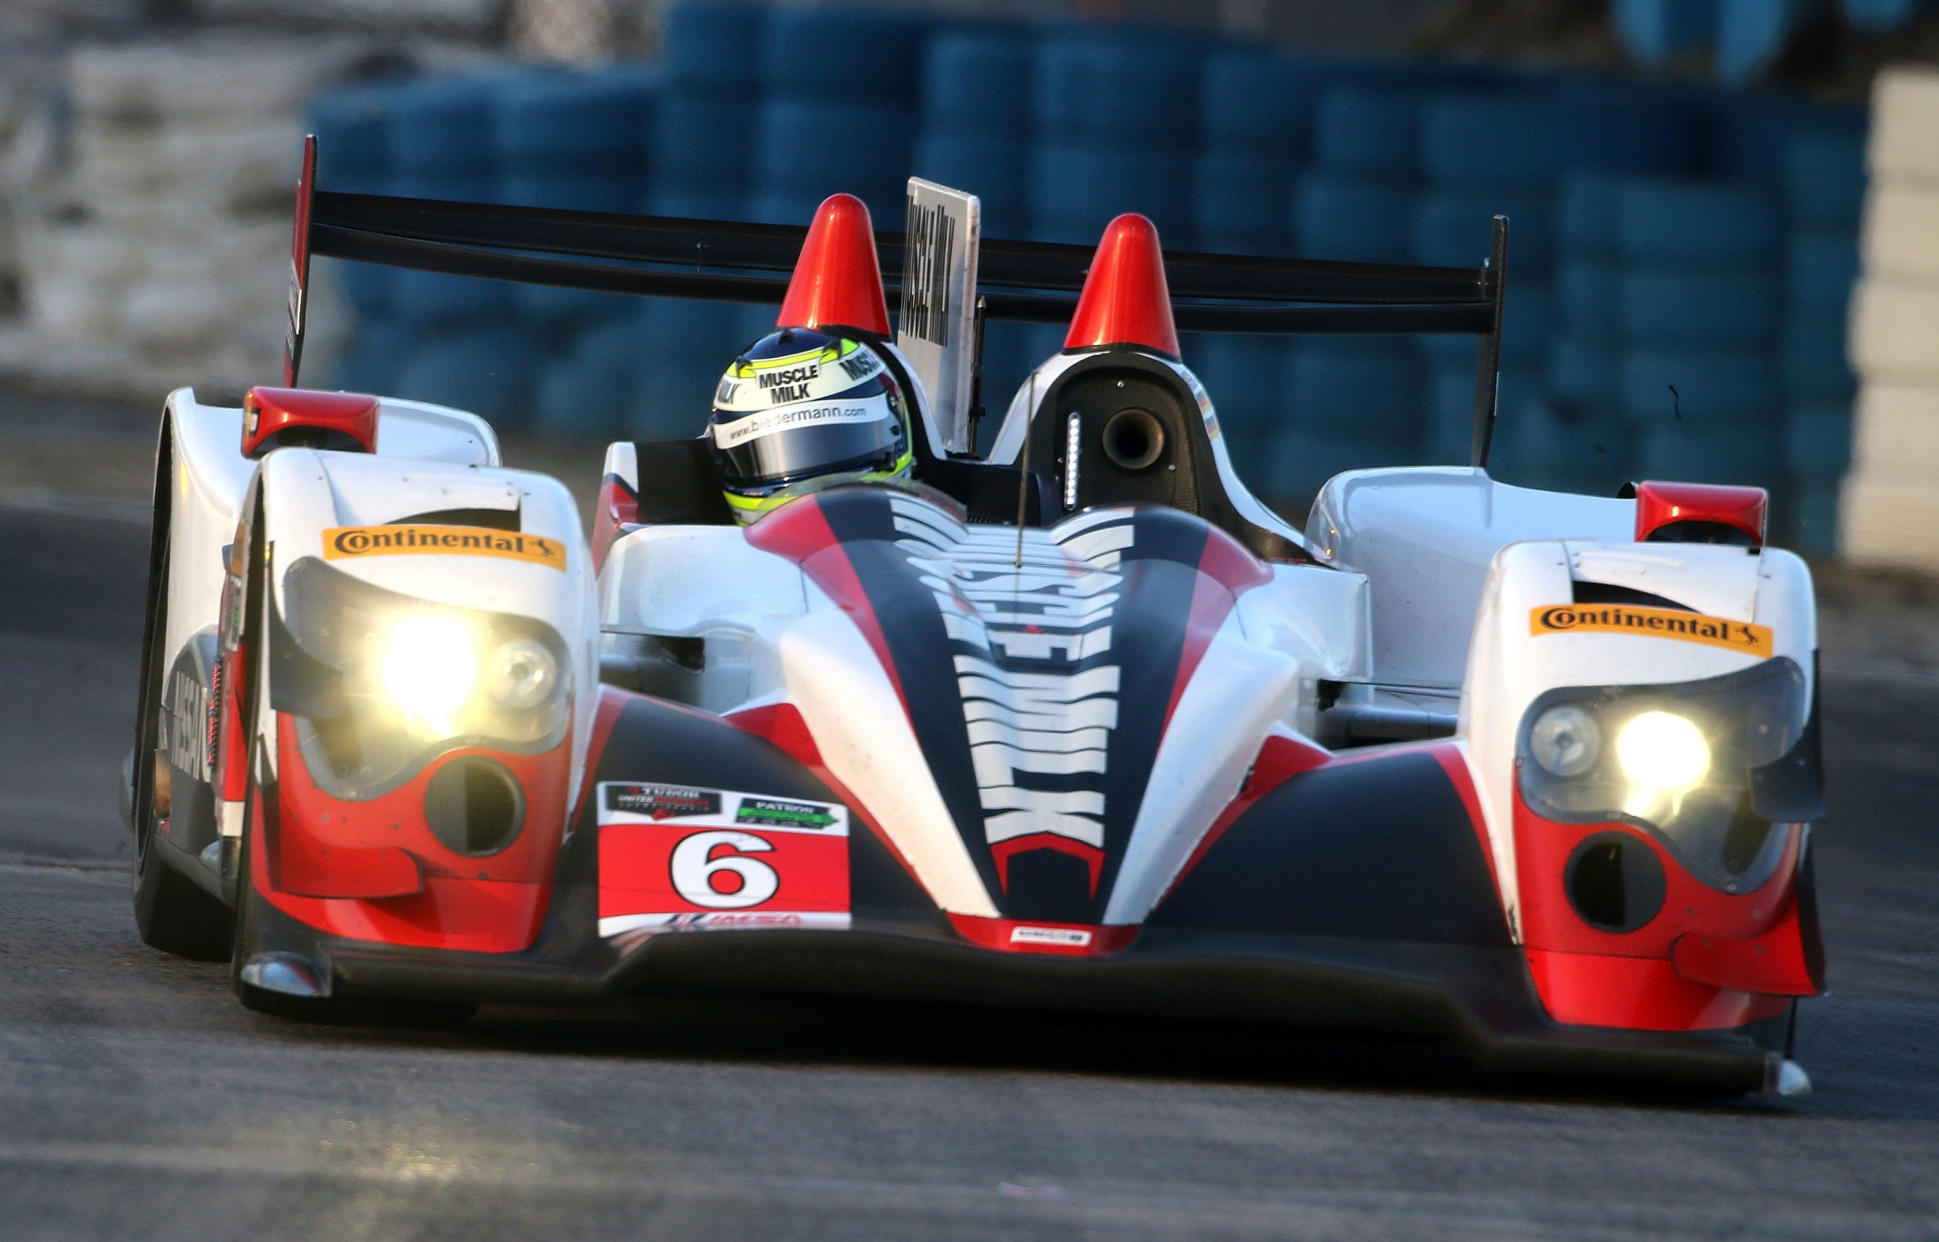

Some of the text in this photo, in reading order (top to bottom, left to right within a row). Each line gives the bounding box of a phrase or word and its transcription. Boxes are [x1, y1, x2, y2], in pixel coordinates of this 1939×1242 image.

[759, 364, 819, 390] MUSCLE
[770, 382, 811, 405] MILK
[334, 529, 524, 554] Continental
[1540, 607, 1729, 640] Continental
[953, 655, 1121, 848] MILK
[668, 829, 780, 909] 6
